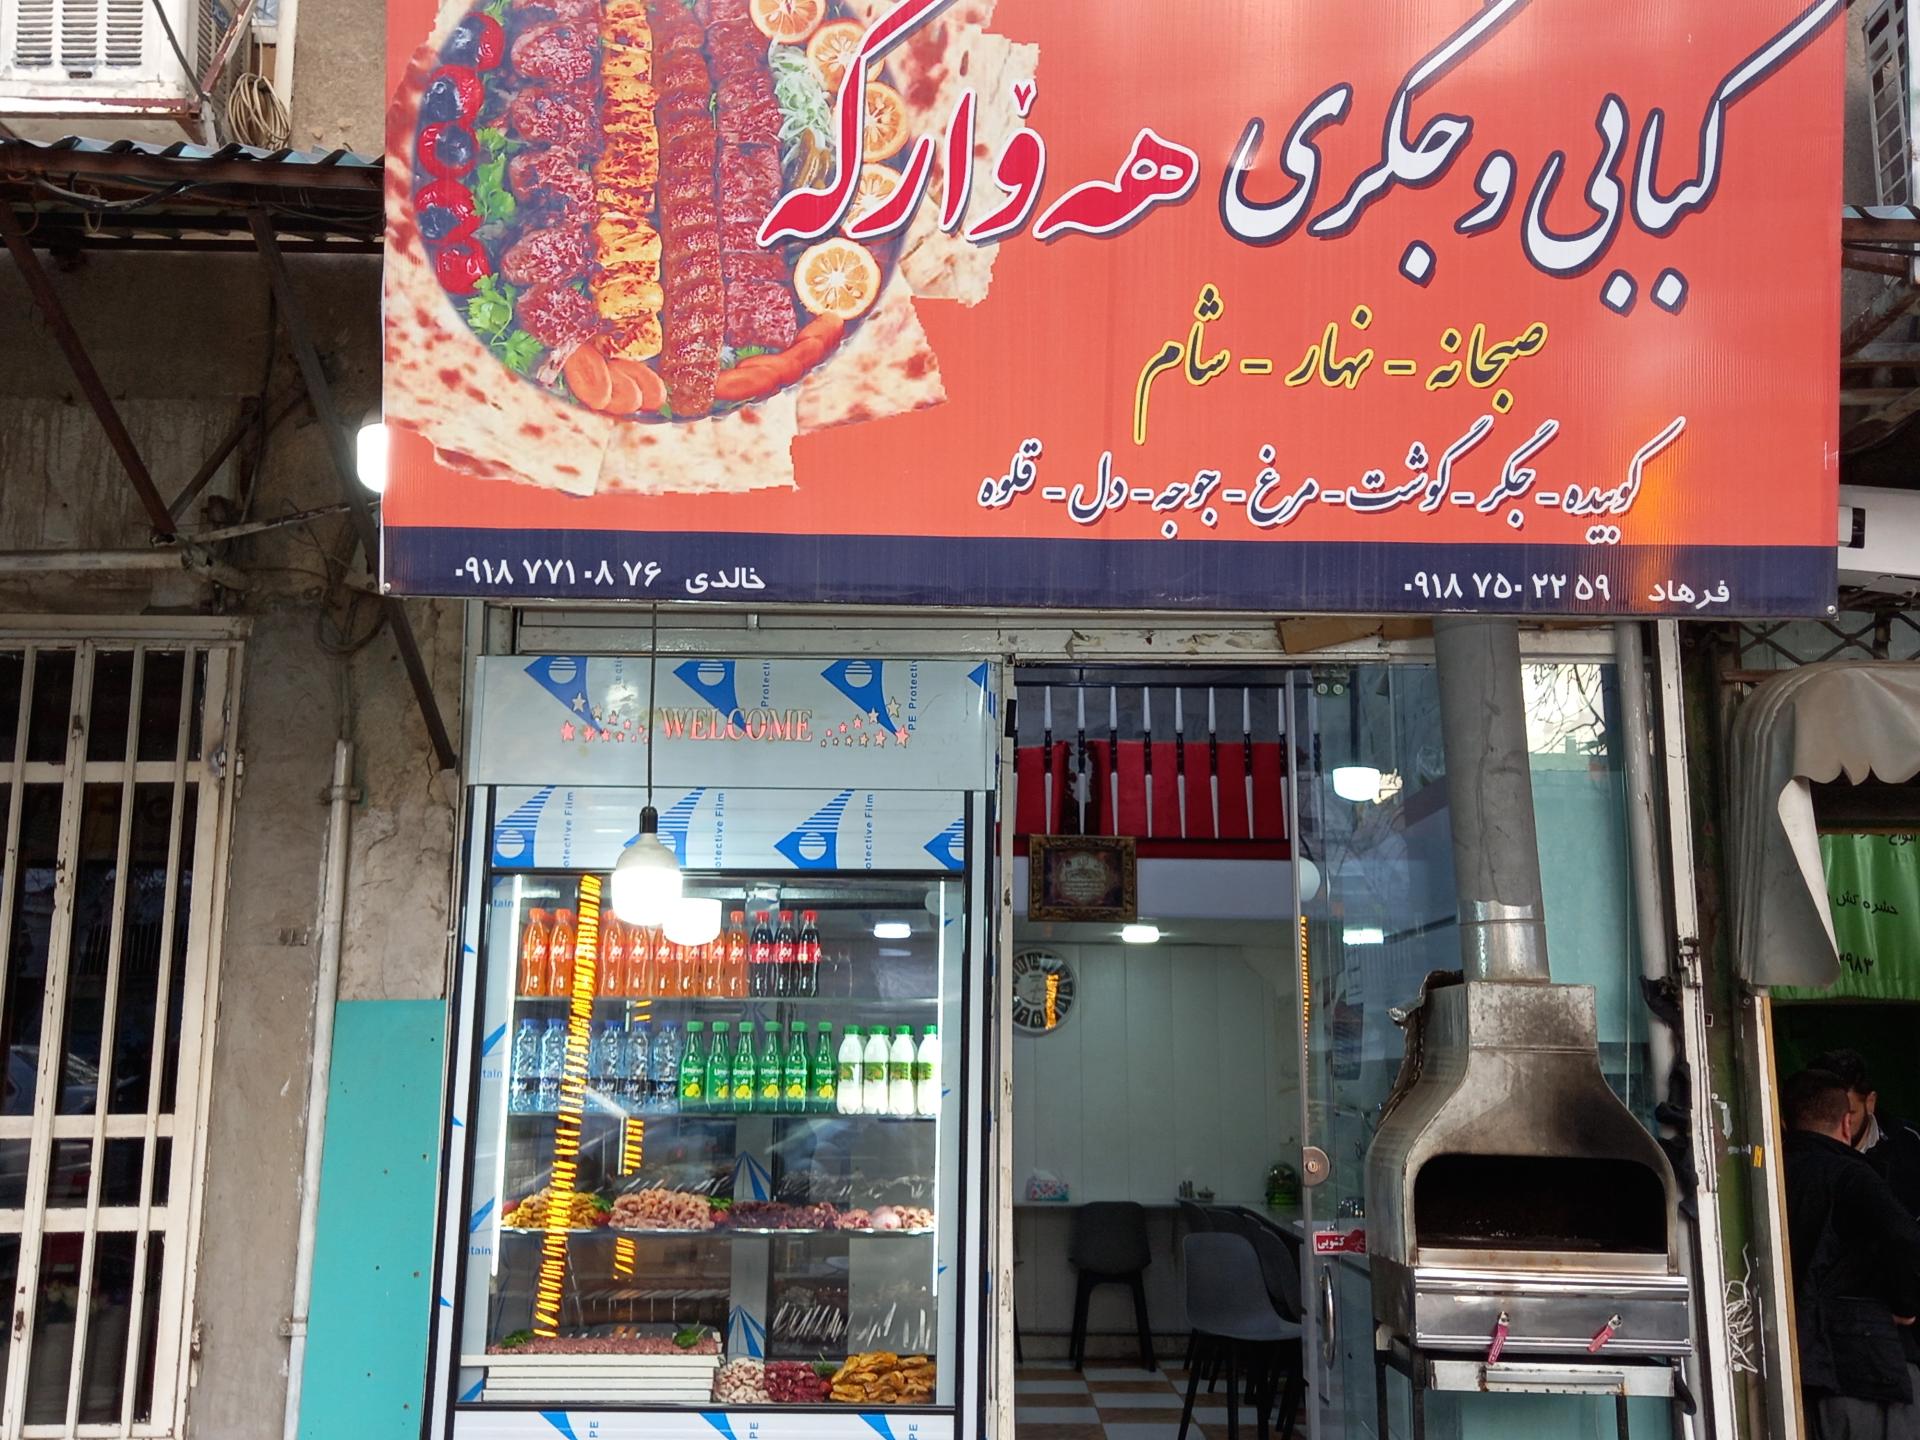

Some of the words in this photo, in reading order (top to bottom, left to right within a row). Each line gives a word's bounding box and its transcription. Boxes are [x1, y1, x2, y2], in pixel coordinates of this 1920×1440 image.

[1521, 0, 1842, 316] کبابی
[1456, 150, 1516, 236] و
[1135, 283, 1231, 444] شام
[1286, 305, 1374, 389] نهار
[1427, 321, 1549, 413] صبحانه
[978, 437, 1043, 505] قلوه
[1067, 450, 1128, 523] دل
[1247, 444, 1319, 527] مرغ
[1347, 414, 1494, 511] گوشت
[1477, 419, 1559, 527] جگر
[1563, 416, 1687, 544] کوبیده
[1152, 469, 1222, 539] جوجه
[455, 557, 514, 584] ۰۹۱۸
[522, 559, 576, 584] ۷۷۱
[584, 560, 615, 585] ۰۸
[623, 561, 662, 587] ۷۶
[685, 567, 766, 594] خالدی
[1404, 571, 1463, 598] ۰۹۱۸
[1472, 573, 1522, 598] ۷۵۰
[1532, 573, 1567, 598] ۲۲
[1575, 574, 1611, 600] ۵۹
[1647, 580, 1730, 609] فرهاد
[658, 706, 813, 741] WELCOME
[908, 715, 917, 730] PE
[564, 792, 574, 815] Film
[715, 793, 725, 816] Film
[865, 794, 874, 818] Film
[1034, 1014, 1041, 1025] 6
[589, 1421, 599, 1438] PE
[750, 1421, 759, 1438] PE
